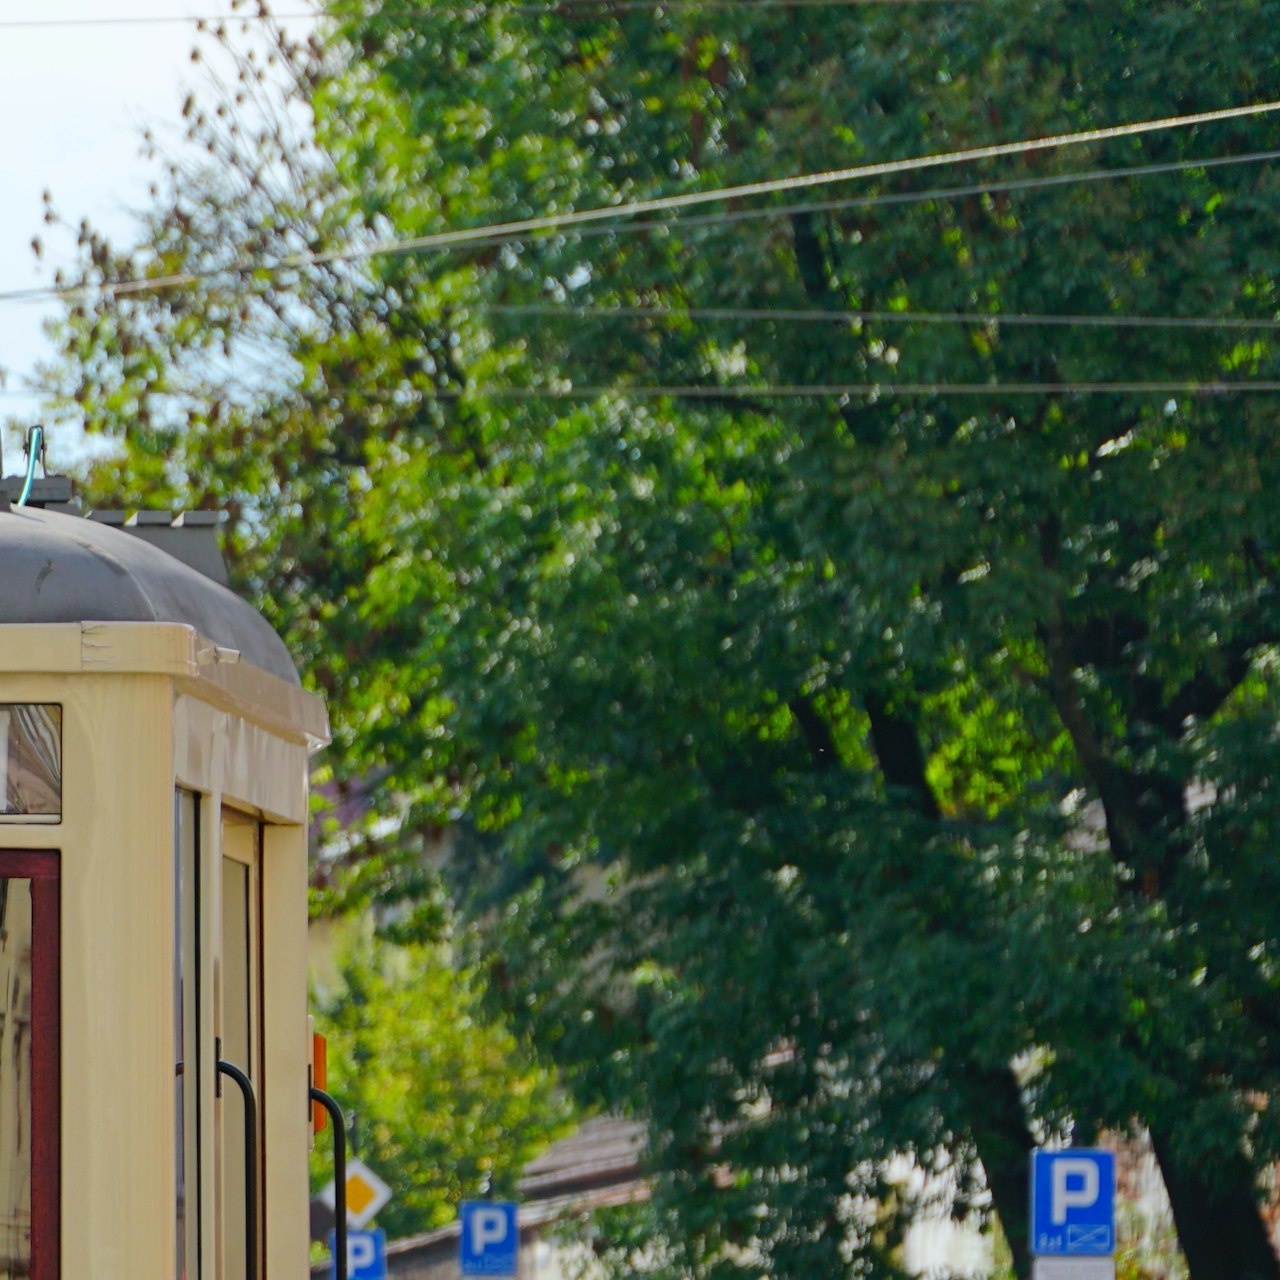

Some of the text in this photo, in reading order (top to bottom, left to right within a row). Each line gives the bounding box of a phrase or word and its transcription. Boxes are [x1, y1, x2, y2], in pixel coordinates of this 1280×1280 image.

[1052, 1157, 1100, 1225] P
[471, 1207, 508, 1255] P
[347, 1235, 376, 1280] P
